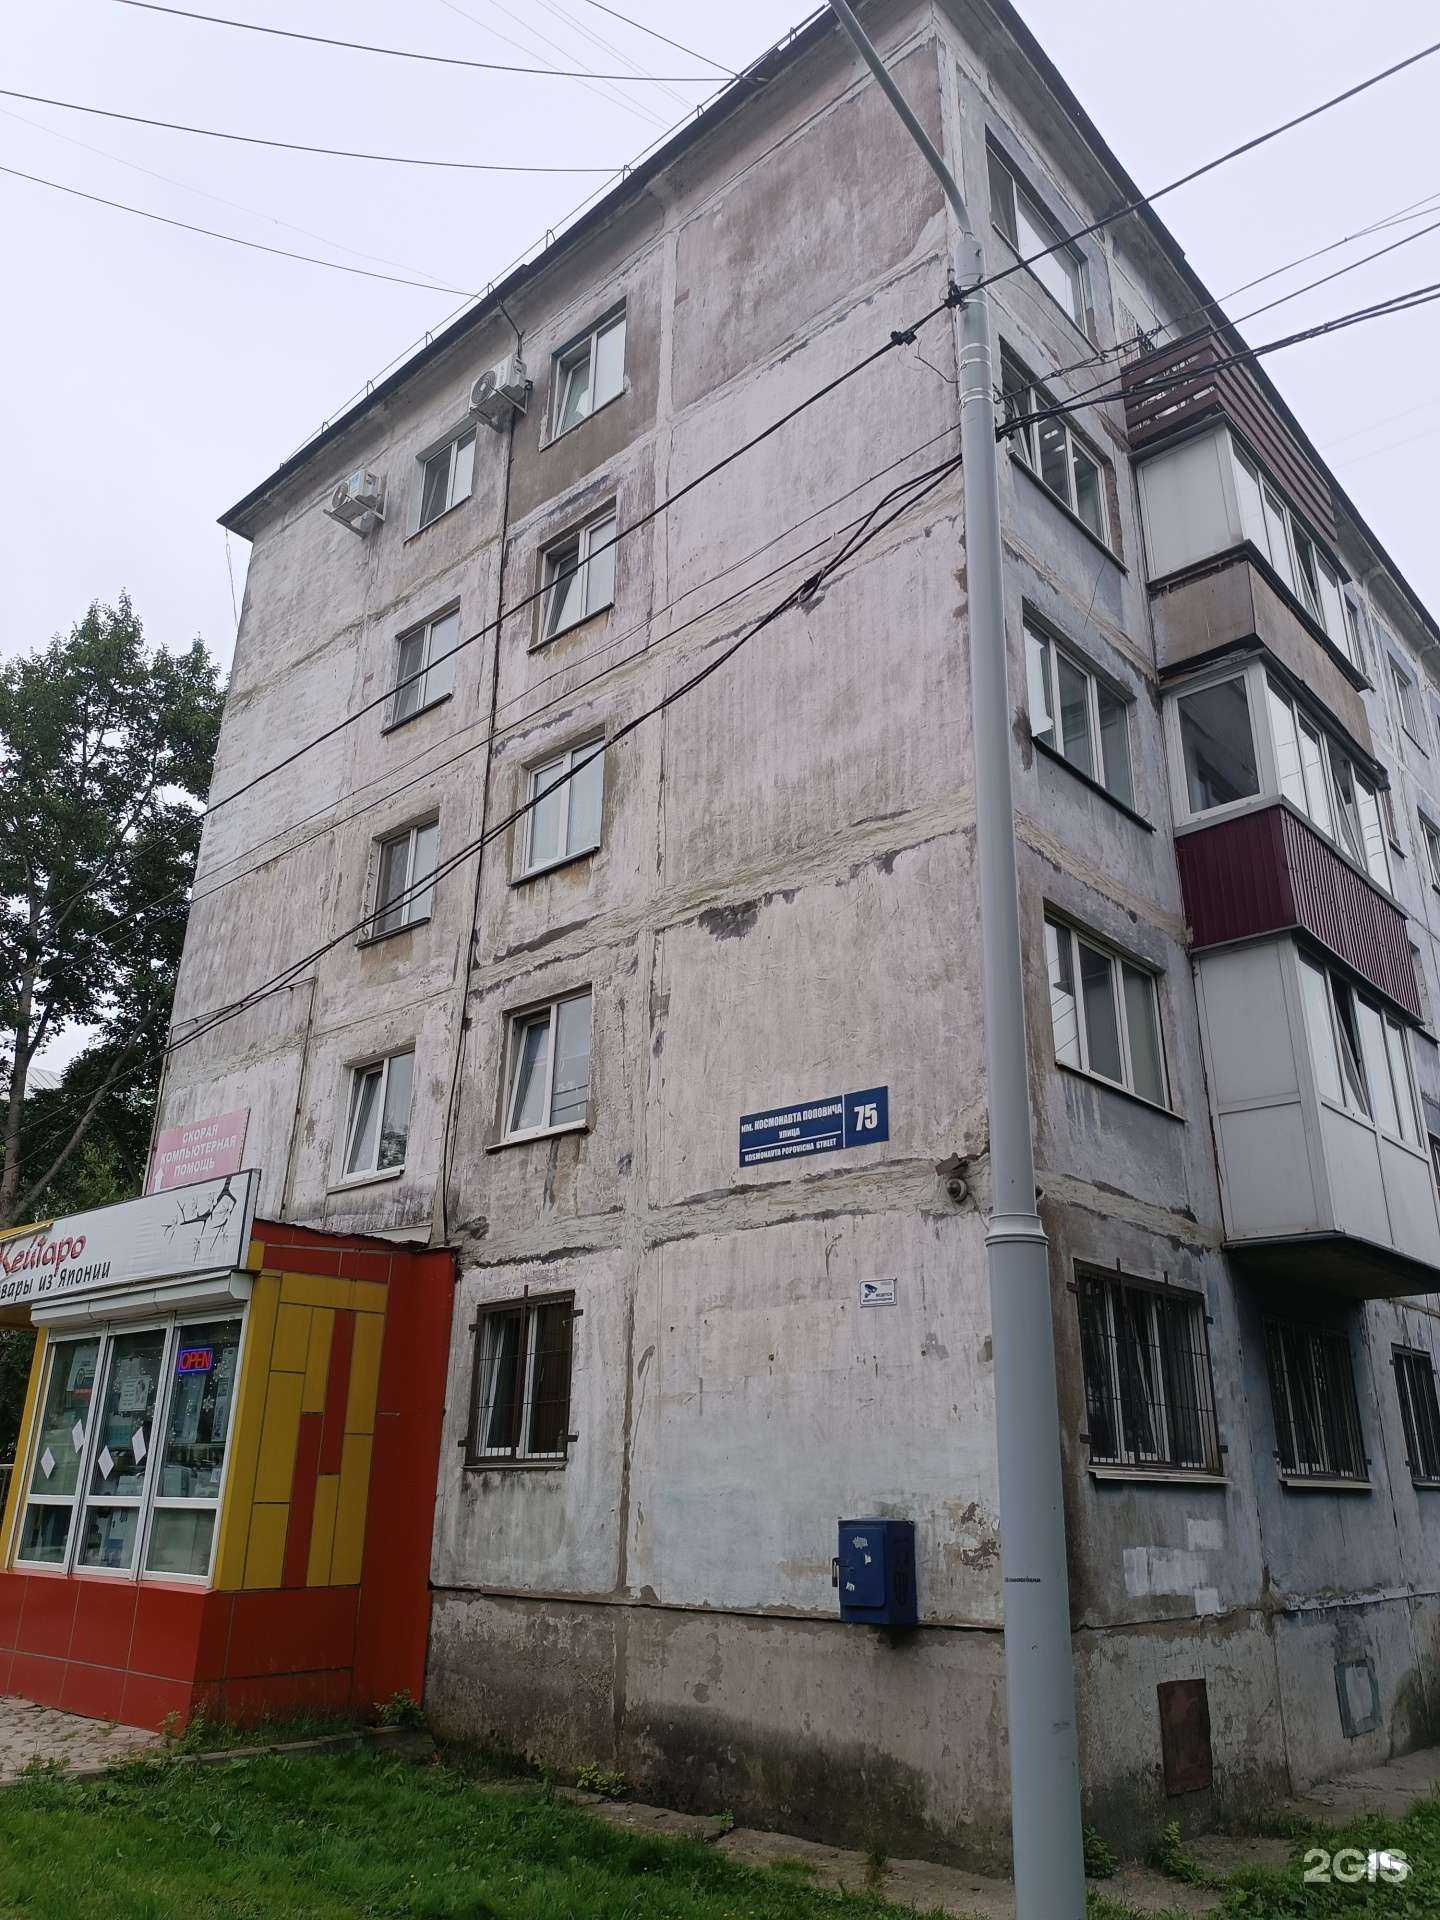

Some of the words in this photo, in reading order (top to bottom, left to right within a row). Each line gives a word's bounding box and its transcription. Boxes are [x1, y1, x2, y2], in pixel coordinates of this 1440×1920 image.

[754, 1111, 802, 1131] КОСМОНАВТА
[803, 1103, 843, 1120] ПОПОВИЧА
[854, 1103, 878, 1131] 75
[182, 1124, 219, 1144] СКОРАЯ
[160, 1135, 237, 1164] КОМПЬЮТЕРНАЯ
[744, 1148, 781, 1162] KOSMONAVTA
[782, 1142, 815, 1155] POPOVICHA
[816, 1138, 837, 1149] STREET
[174, 1158, 216, 1177] ПОМОЩЬ
[39, 1273, 53, 1292] из
[182, 1352, 210, 1369] OPEN
